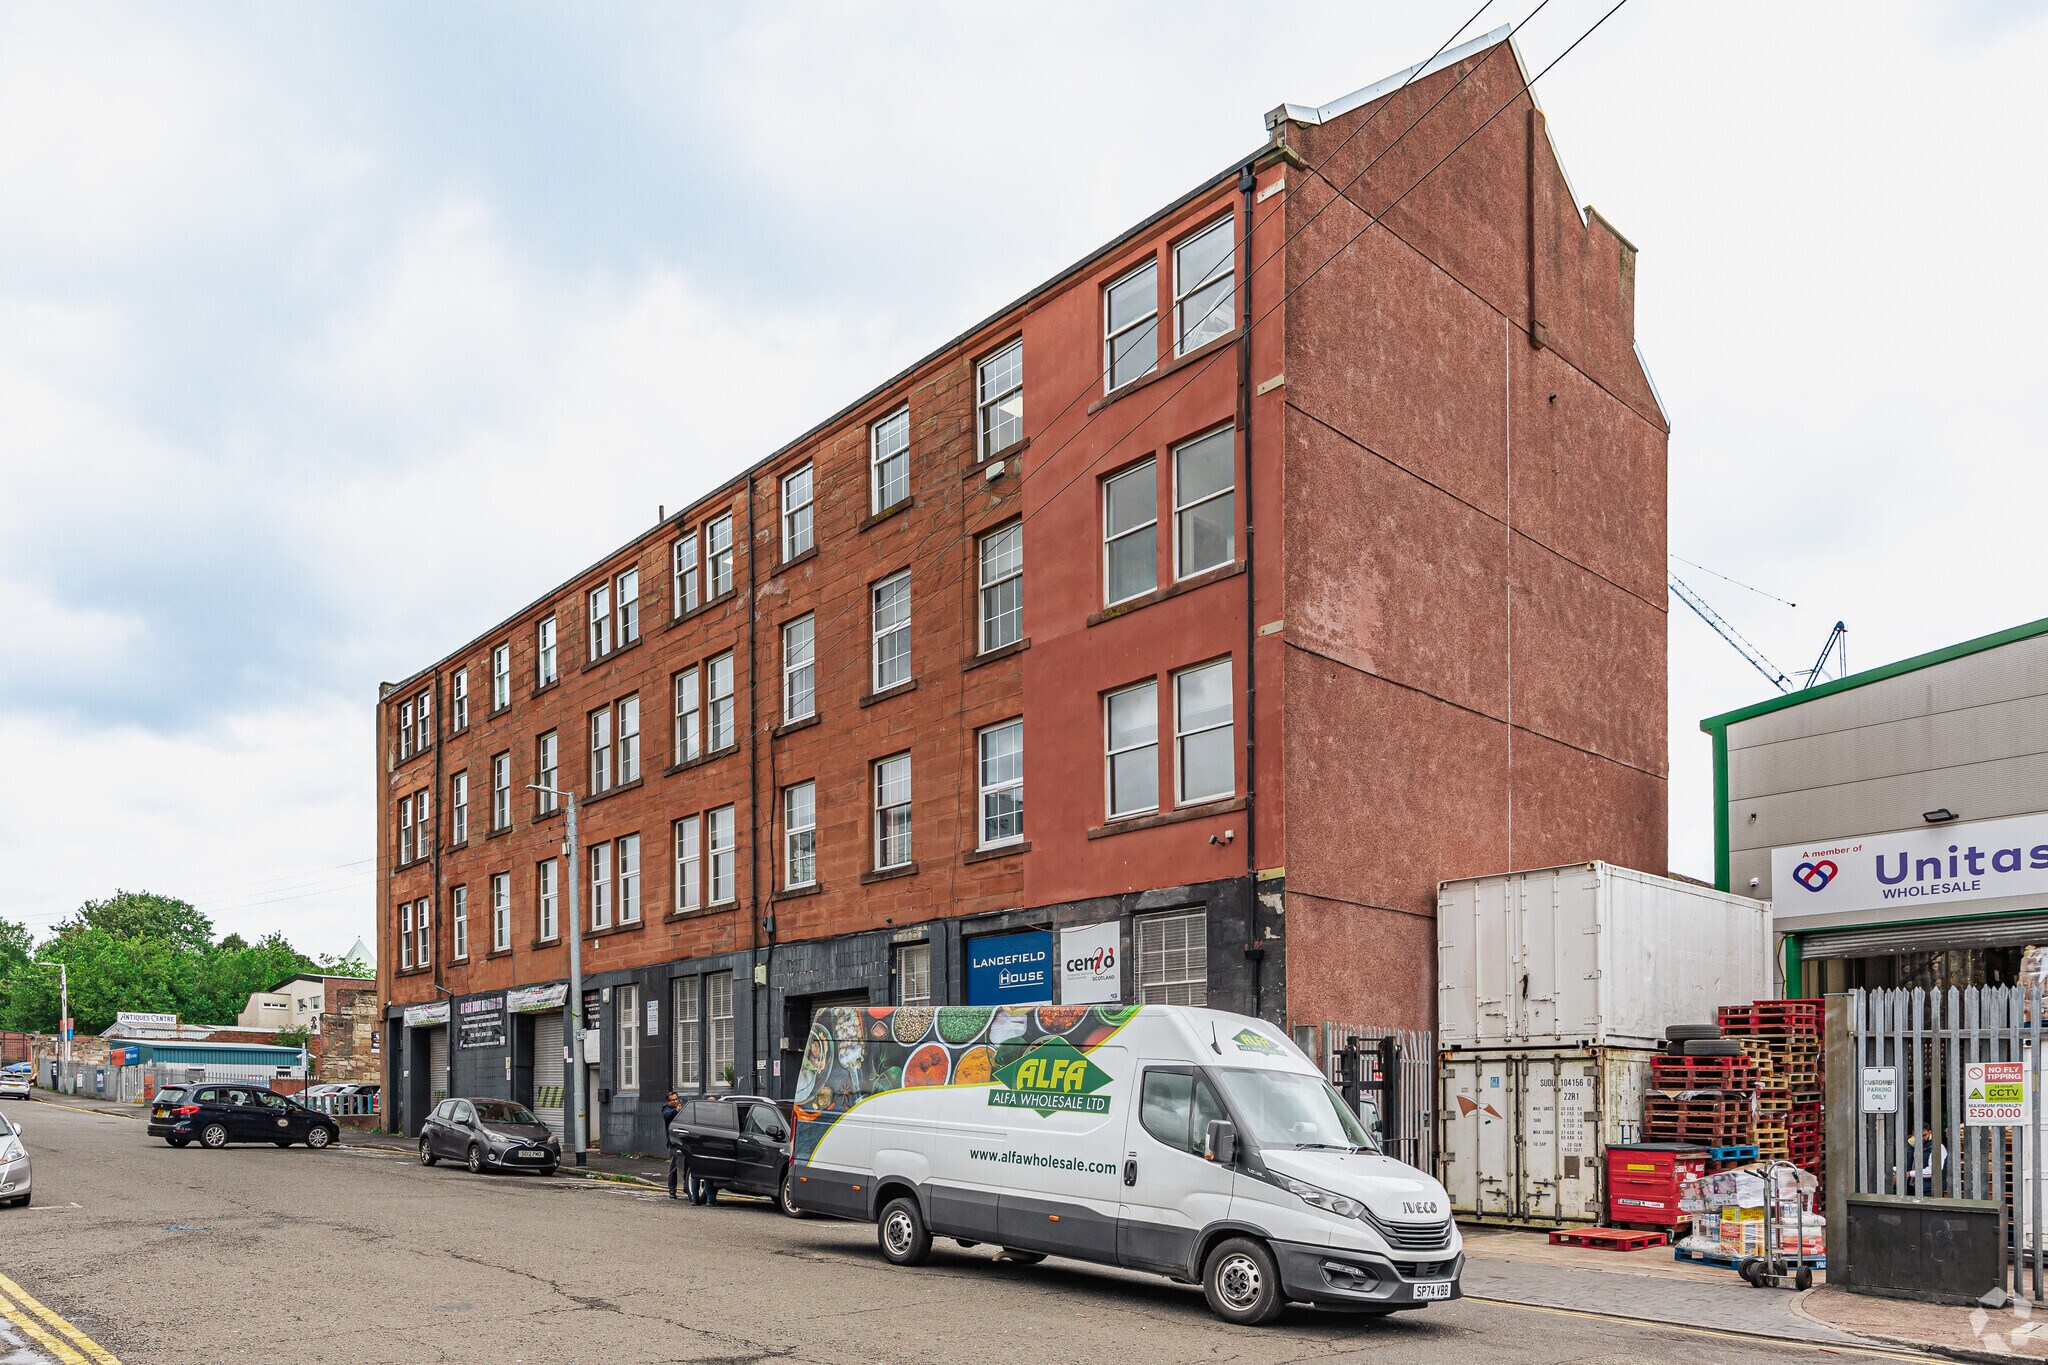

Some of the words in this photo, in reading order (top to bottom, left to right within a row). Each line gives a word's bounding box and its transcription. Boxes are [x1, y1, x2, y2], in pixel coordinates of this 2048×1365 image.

[1812, 848, 1849, 857] member
[1853, 844, 1862, 852] of
[1875, 844, 2048, 885] Unitas
[1882, 880, 1981, 899] WHOLESALE
[973, 951, 1046, 969] LANCEFIELD
[999, 970, 1044, 984] HOUSE
[1092, 974, 1115, 982] SCOTLAND
[120, 1013, 150, 1021] ANTIQUES
[151, 1014, 174, 1022] CENTRE
[1240, 1034, 1272, 1048] ALFA
[1016, 1058, 1088, 1093] ALFA
[1540, 1079, 1555, 1087] SUDU
[1560, 1079, 1583, 1087] 104156
[1563, 1092, 1579, 1101] 22R1
[1989, 1089, 2019, 1097] CCTV
[993, 1092, 1017, 1105] ALFA
[1020, 1093, 1083, 1109] WHOLESALE
[1086, 1097, 1105, 1111] LTD
[1969, 1108, 2021, 1118] £50,000
[970, 1149, 1116, 1175] www.alfawholesale.com
[1402, 1201, 1438, 1214] IVECO
[1416, 1285, 1435, 1297] SP74
[1436, 1284, 1449, 1296] VBB
